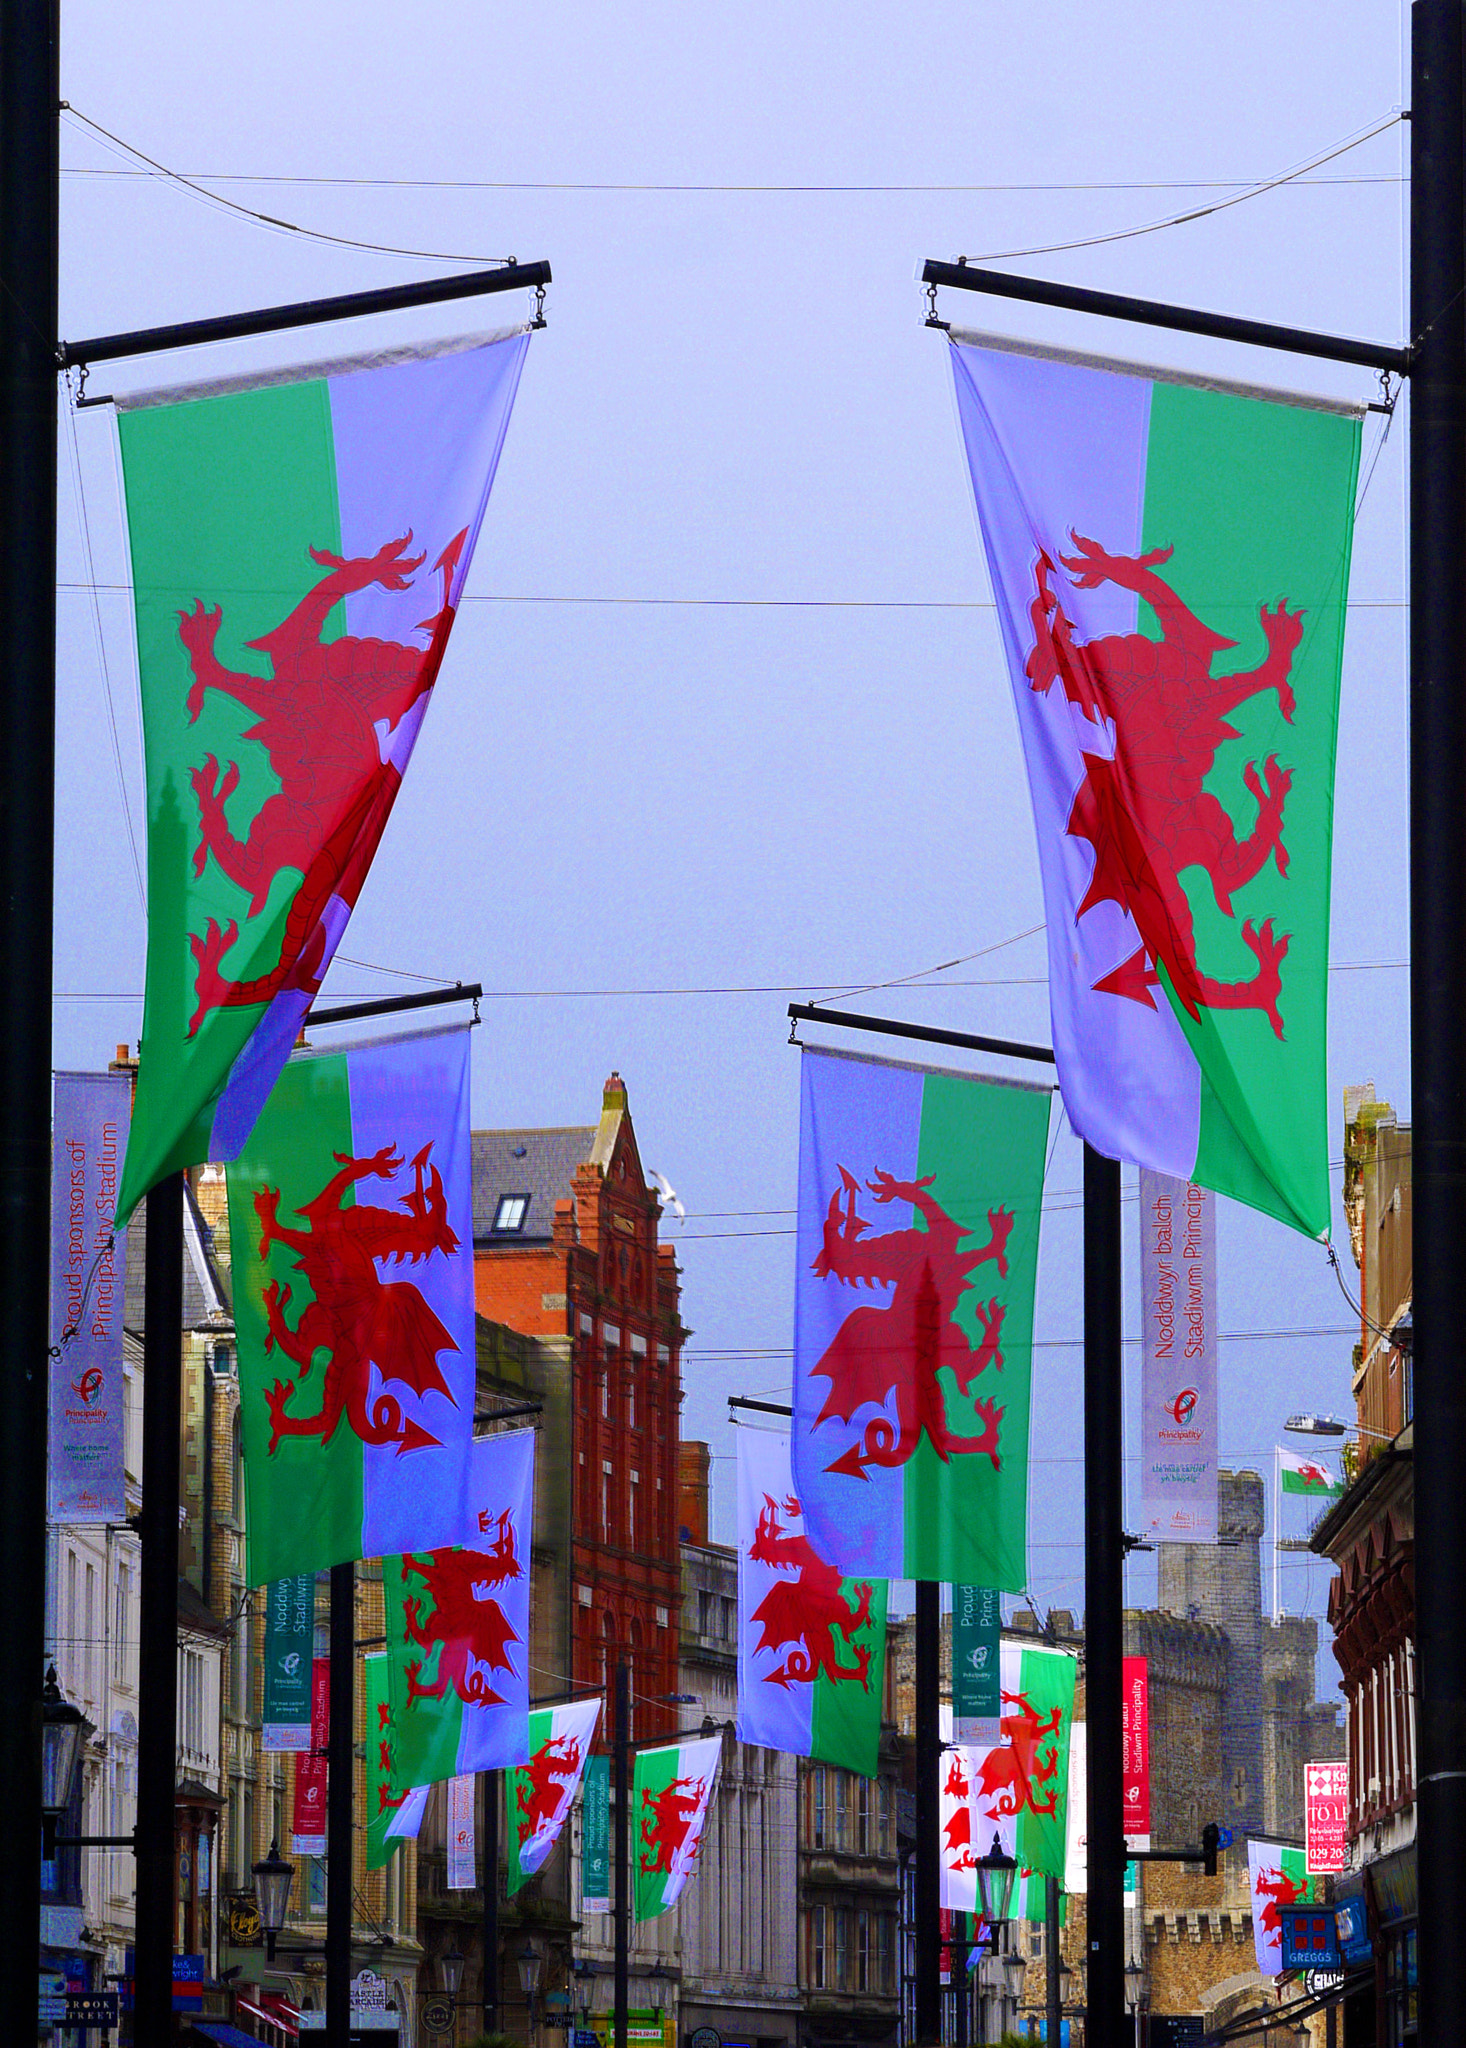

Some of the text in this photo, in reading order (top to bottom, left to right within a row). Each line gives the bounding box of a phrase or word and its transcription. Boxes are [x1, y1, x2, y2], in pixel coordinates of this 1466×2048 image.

[63, 1139, 86, 1338] Proud sponsors of
[92, 1122, 117, 1338] Principality Stadium
[1152, 1194, 1178, 1358] Noddwyr balch
[1183, 1263, 1204, 1358] Stadiwm
[66, 1409, 107, 1419] Principality
[1158, 1430, 1202, 1440] Principality
[961, 1586, 974, 1627] Proud
[315, 1680, 326, 1720] Stadium
[1132, 1678, 1144, 1774] Stadiwm Principality
[597, 1773, 607, 1849] Principality Stadium
[1308, 1807, 1330, 1821] TO
[1310, 1848, 1327, 1859] 029
[1289, 1952, 1331, 1962] GREGGS
[67, 2012, 115, 2020] TREET
